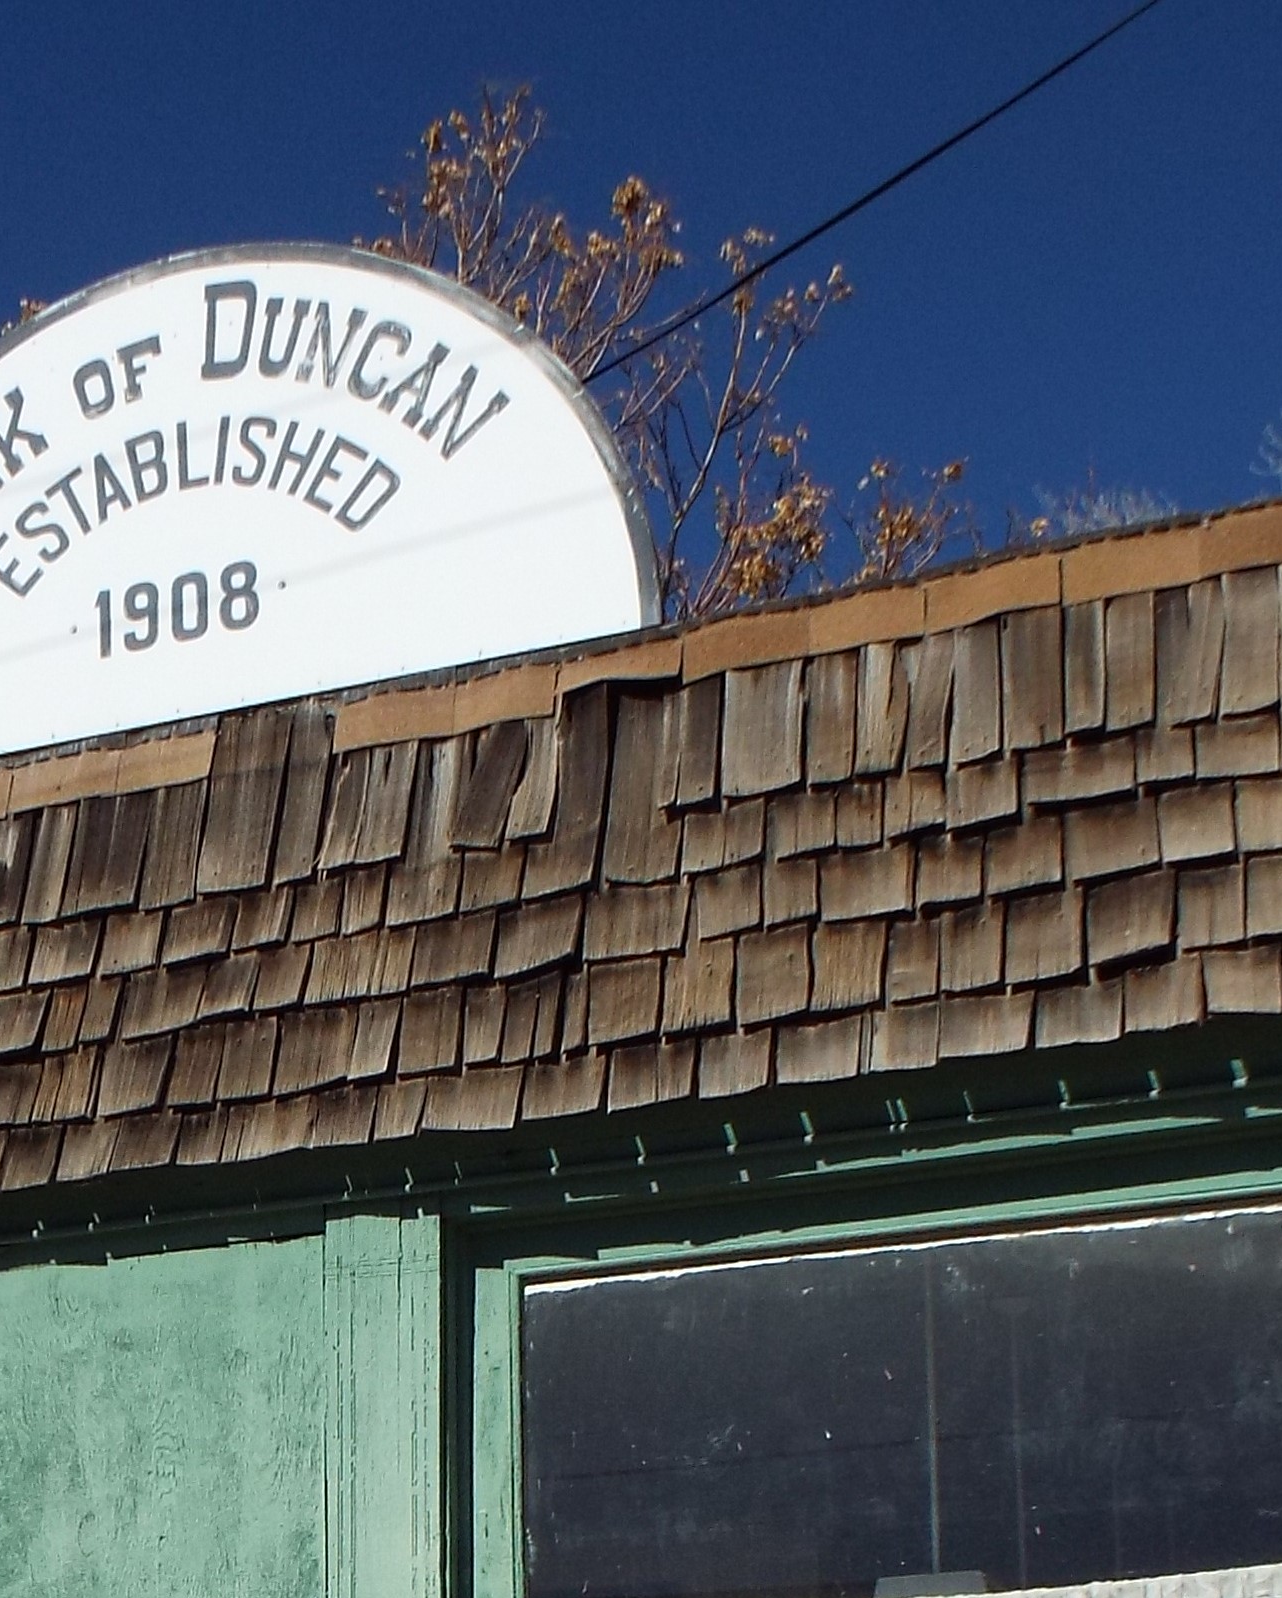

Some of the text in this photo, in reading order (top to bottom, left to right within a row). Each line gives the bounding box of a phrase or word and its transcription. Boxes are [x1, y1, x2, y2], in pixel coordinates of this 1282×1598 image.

[72, 334, 162, 419] OF
[200, 279, 510, 461] DUNCAN
[95, 560, 260, 659] 1908
